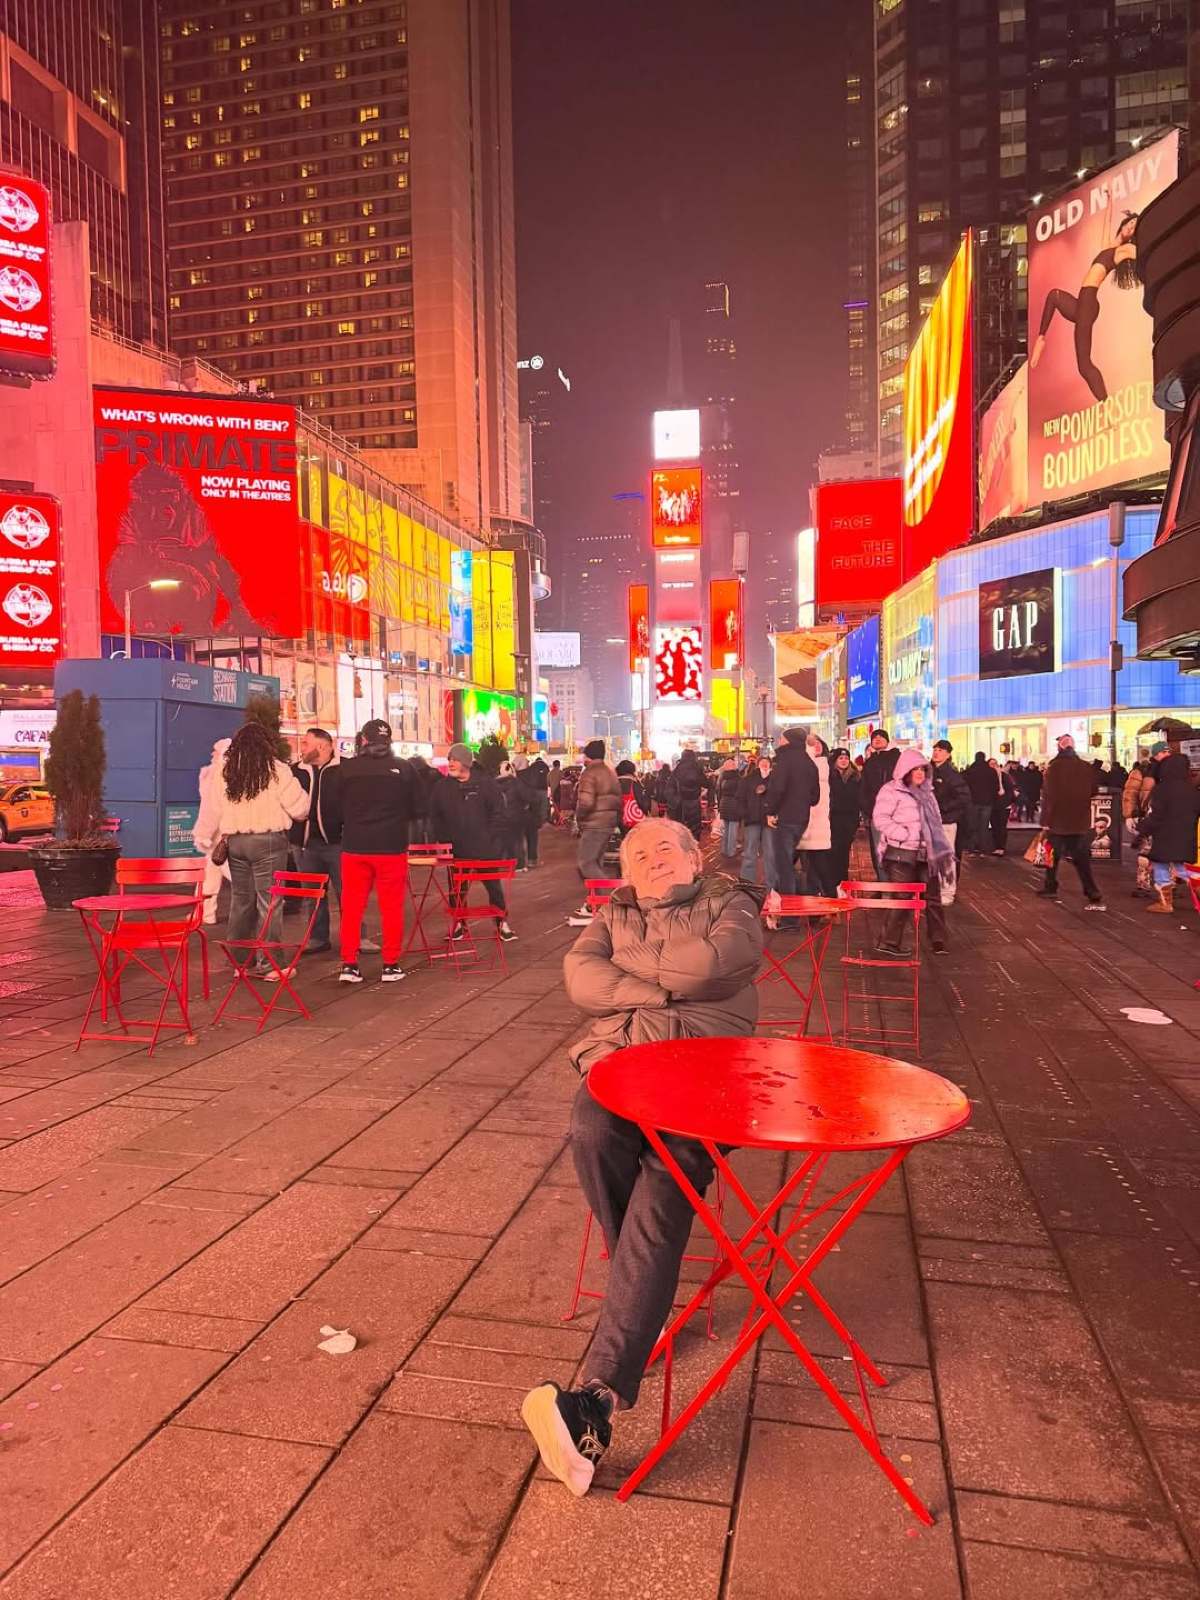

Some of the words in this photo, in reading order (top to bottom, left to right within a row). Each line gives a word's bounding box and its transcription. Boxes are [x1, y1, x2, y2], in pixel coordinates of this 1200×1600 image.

[1036, 199, 1084, 241] OLD
[1090, 151, 1164, 216] NAVY
[101, 408, 156, 423] WHAT'S
[159, 412, 213, 427] WRONG
[216, 416, 250, 430] WITH
[253, 419, 289, 432] BEN?
[1043, 418, 1061, 438] NEW
[1060, 381, 1154, 444] POWERSOFT
[95, 427, 297, 474] PRIMATE
[1043, 417, 1153, 490] BOUNDLESS
[201, 476, 233, 487] NOW
[237, 478, 291, 491] PLAYING
[201, 488, 227, 498] ONLY
[229, 490, 240, 498] IN
[242, 491, 291, 501] THEATRES
[831, 515, 873, 529] FACE
[863, 539, 896, 553] THE
[831, 551, 897, 570] FUTURE
[992, 601, 1038, 651] GAP
[888, 658, 902, 686] OLD
